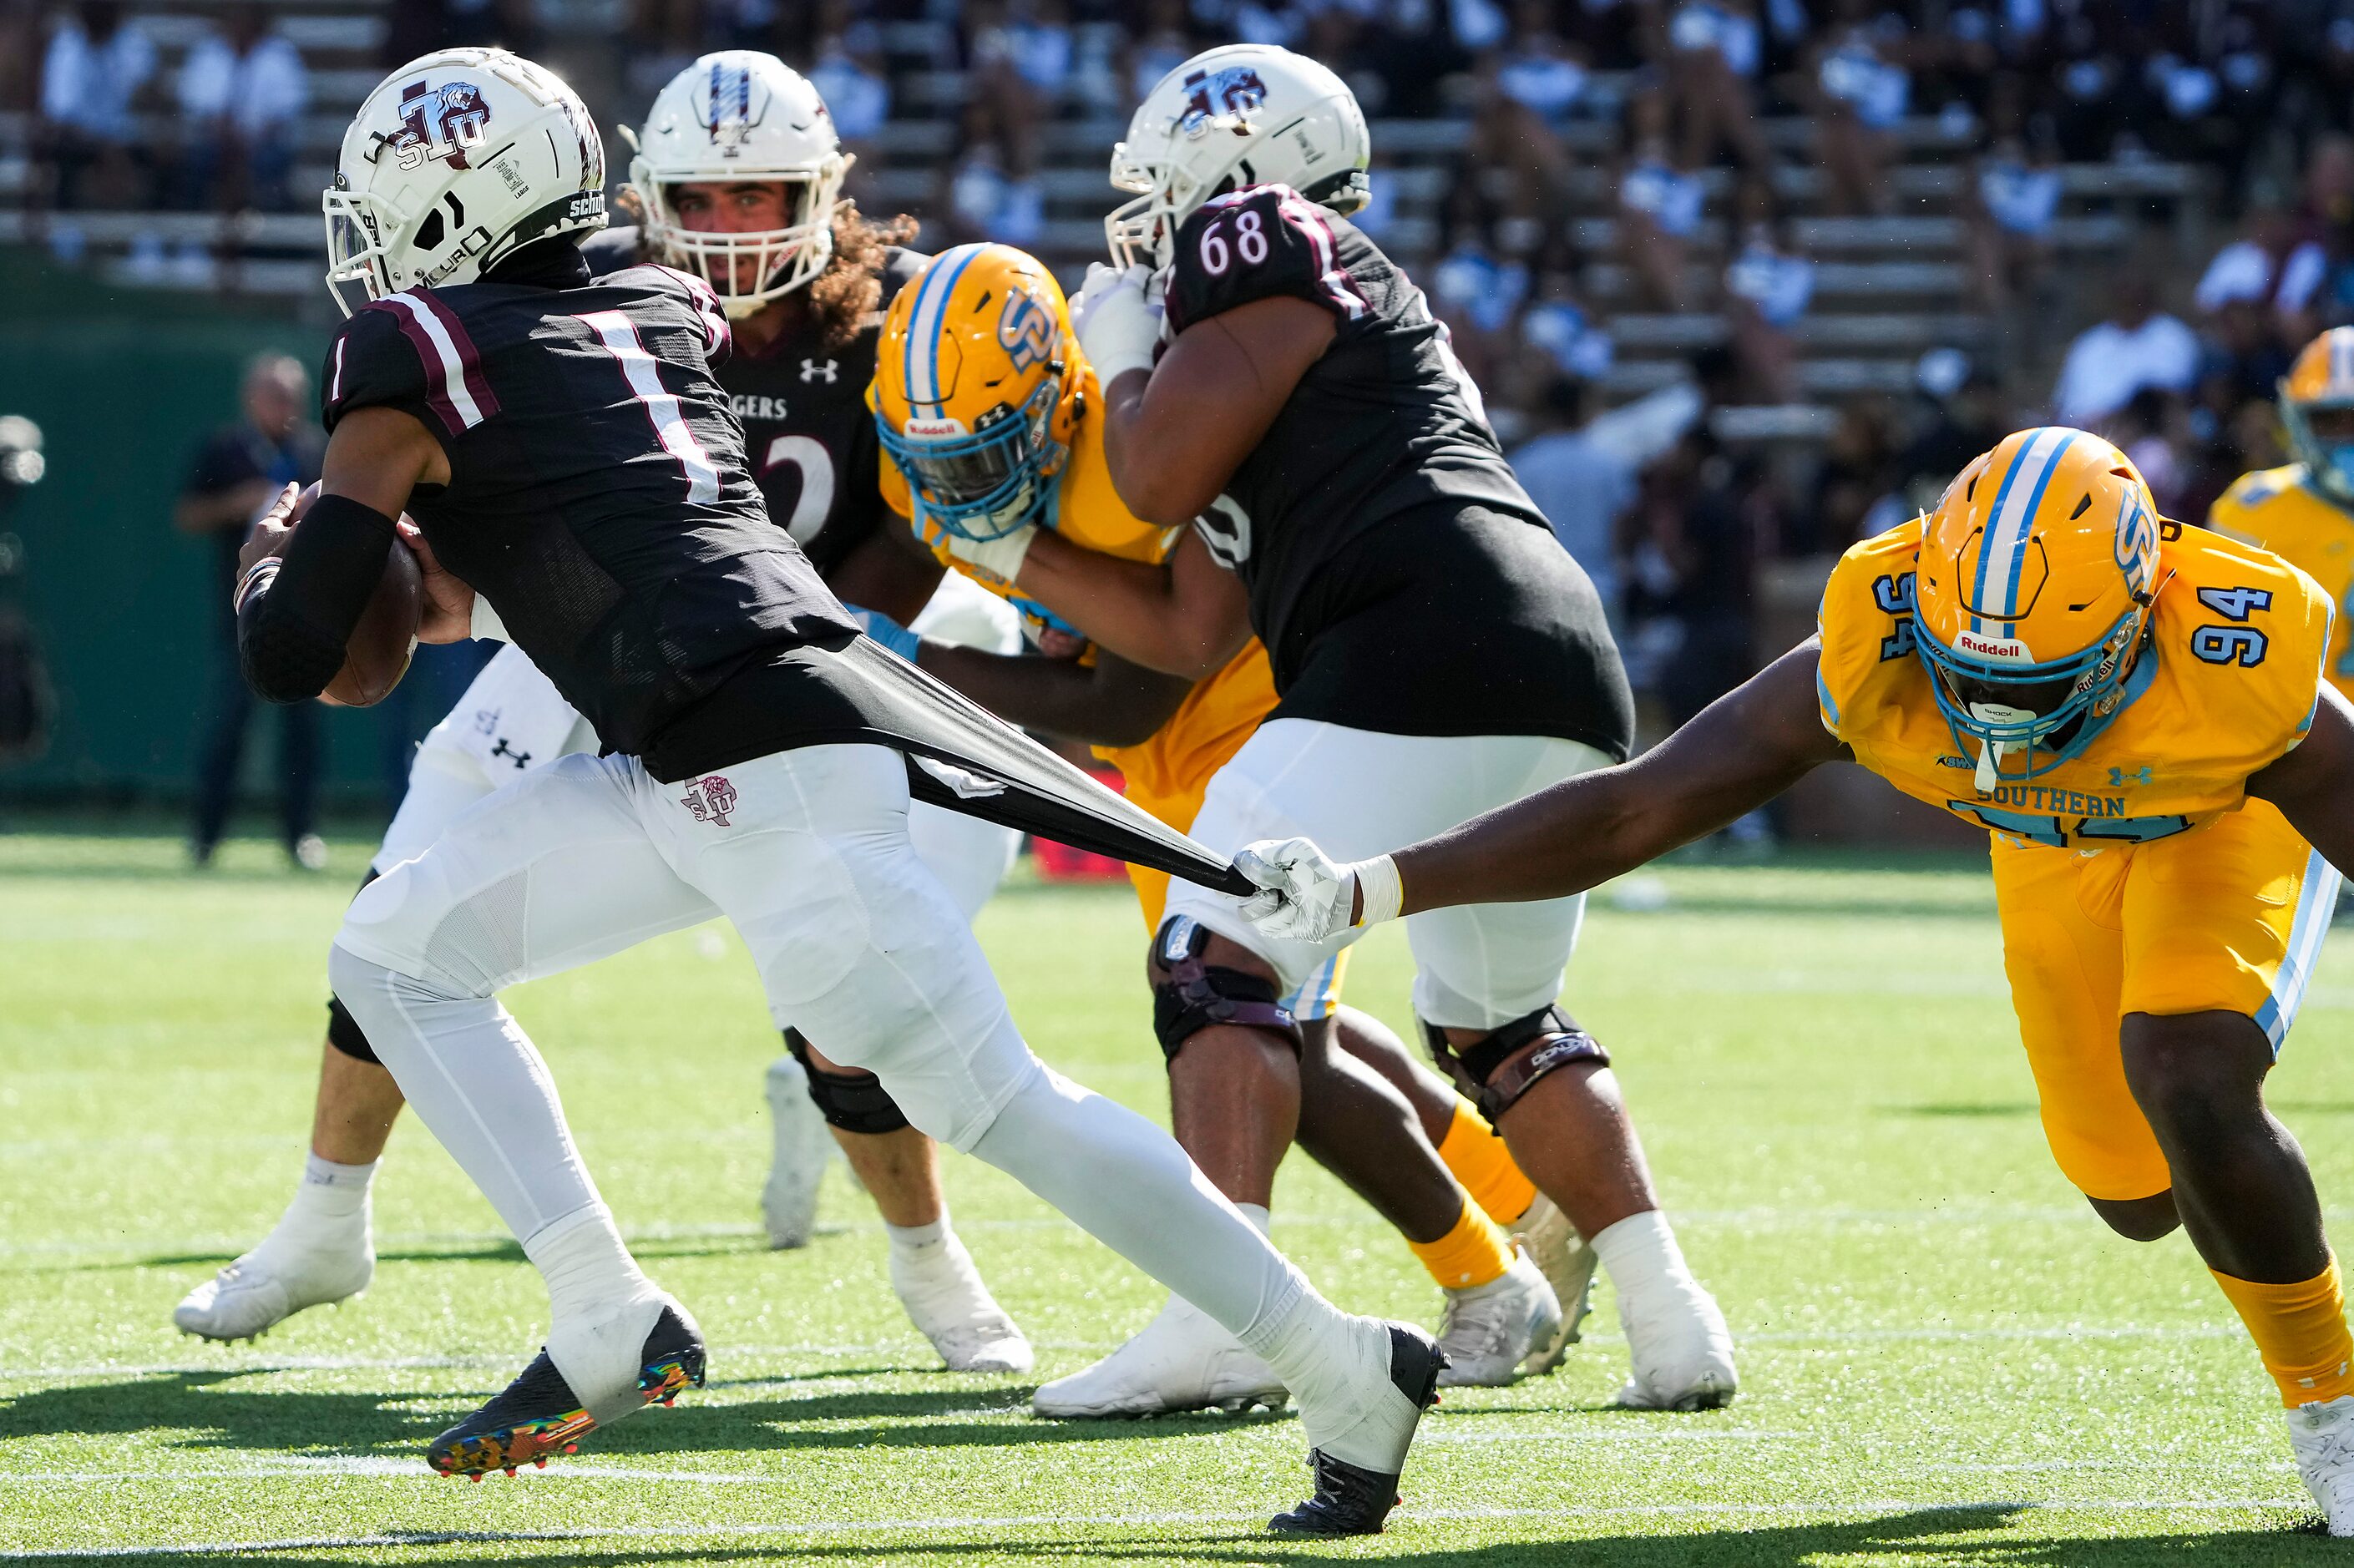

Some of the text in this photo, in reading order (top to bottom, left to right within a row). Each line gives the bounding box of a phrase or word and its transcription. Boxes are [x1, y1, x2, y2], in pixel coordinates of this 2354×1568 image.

[514, 185, 529, 200] LARGE
[1200, 210, 1268, 276] 68
[332, 335, 346, 402] 1
[572, 309, 723, 504] 1
[2189, 586, 2274, 668] 94
[1961, 636, 2020, 657] Riddell
[2077, 660, 2115, 693] Ridell
[1984, 707, 2012, 717] SHOCK
[1977, 785, 2126, 817] SOUTHERN
